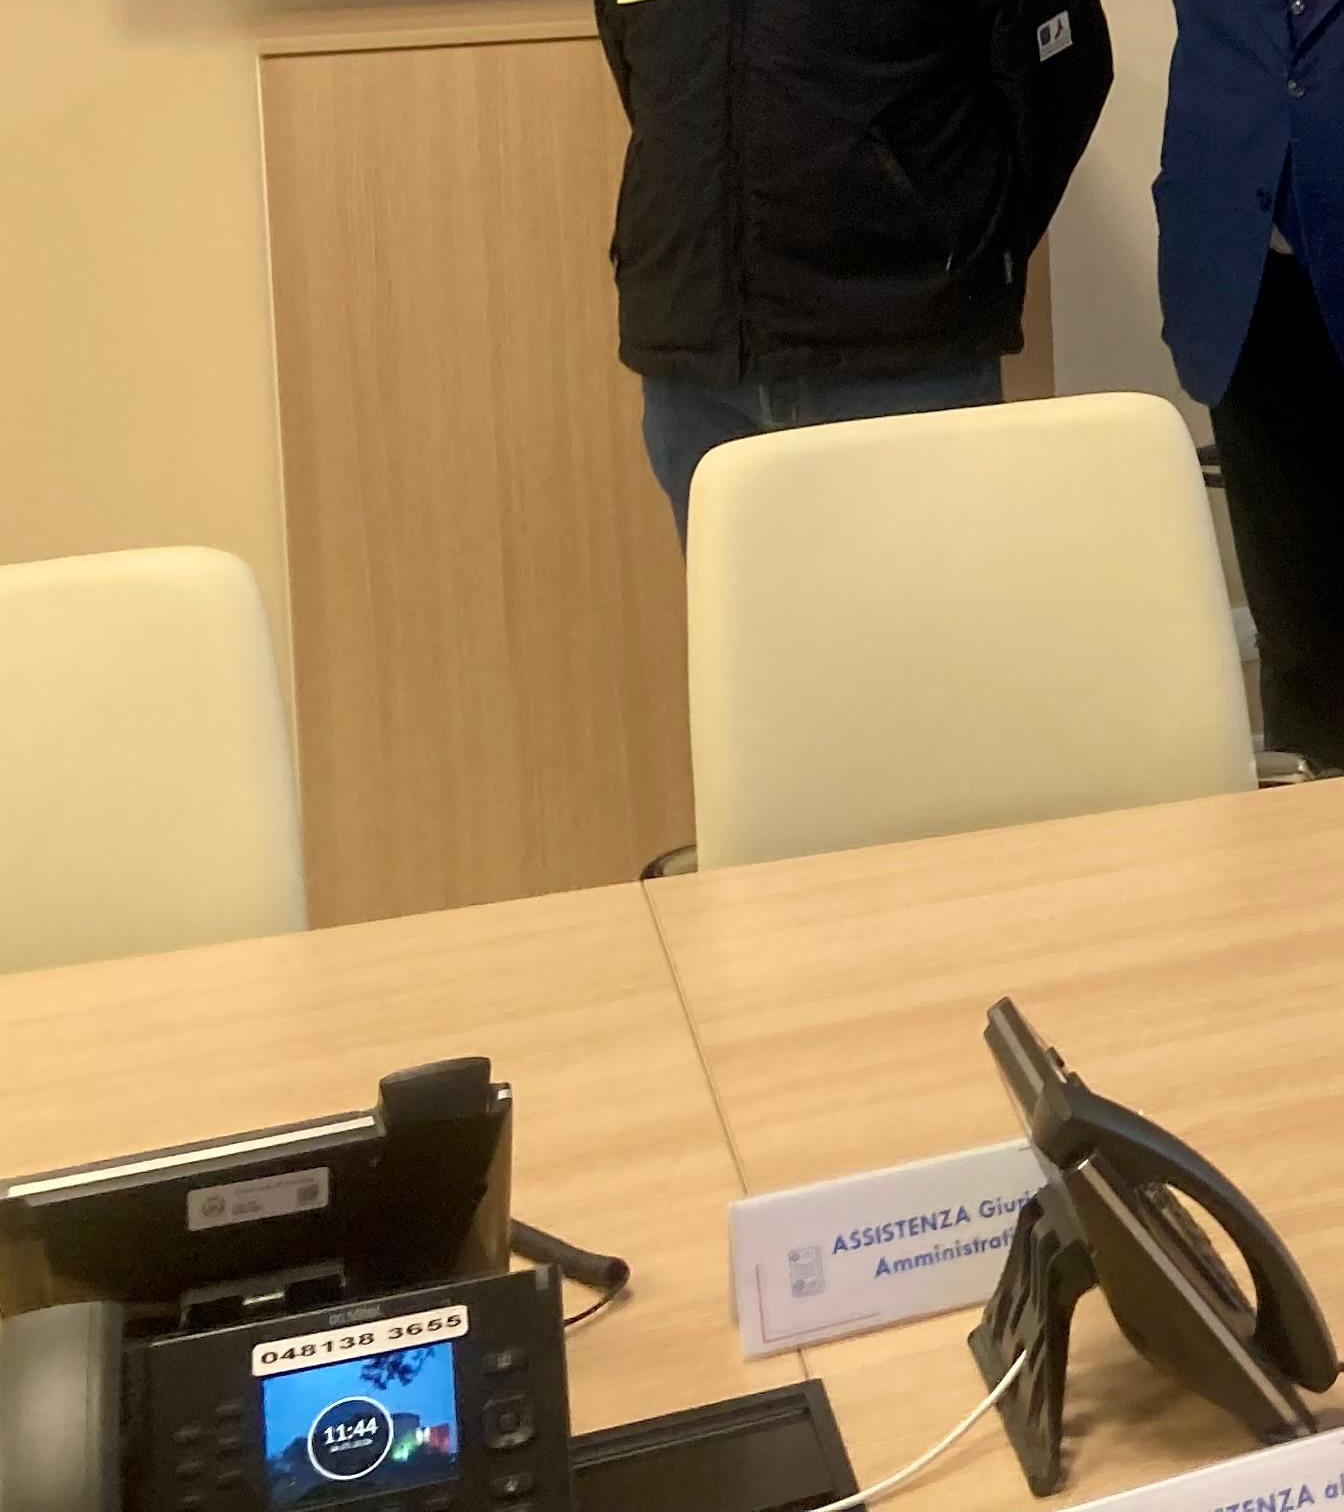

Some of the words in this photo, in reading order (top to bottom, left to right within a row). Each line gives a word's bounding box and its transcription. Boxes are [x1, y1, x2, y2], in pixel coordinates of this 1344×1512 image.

[832, 1205, 971, 1256] ASSISTENZA
[261, 1332, 376, 1365] 048138
[388, 1314, 462, 1340] 3655
[324, 1416, 380, 1445] 11:44
